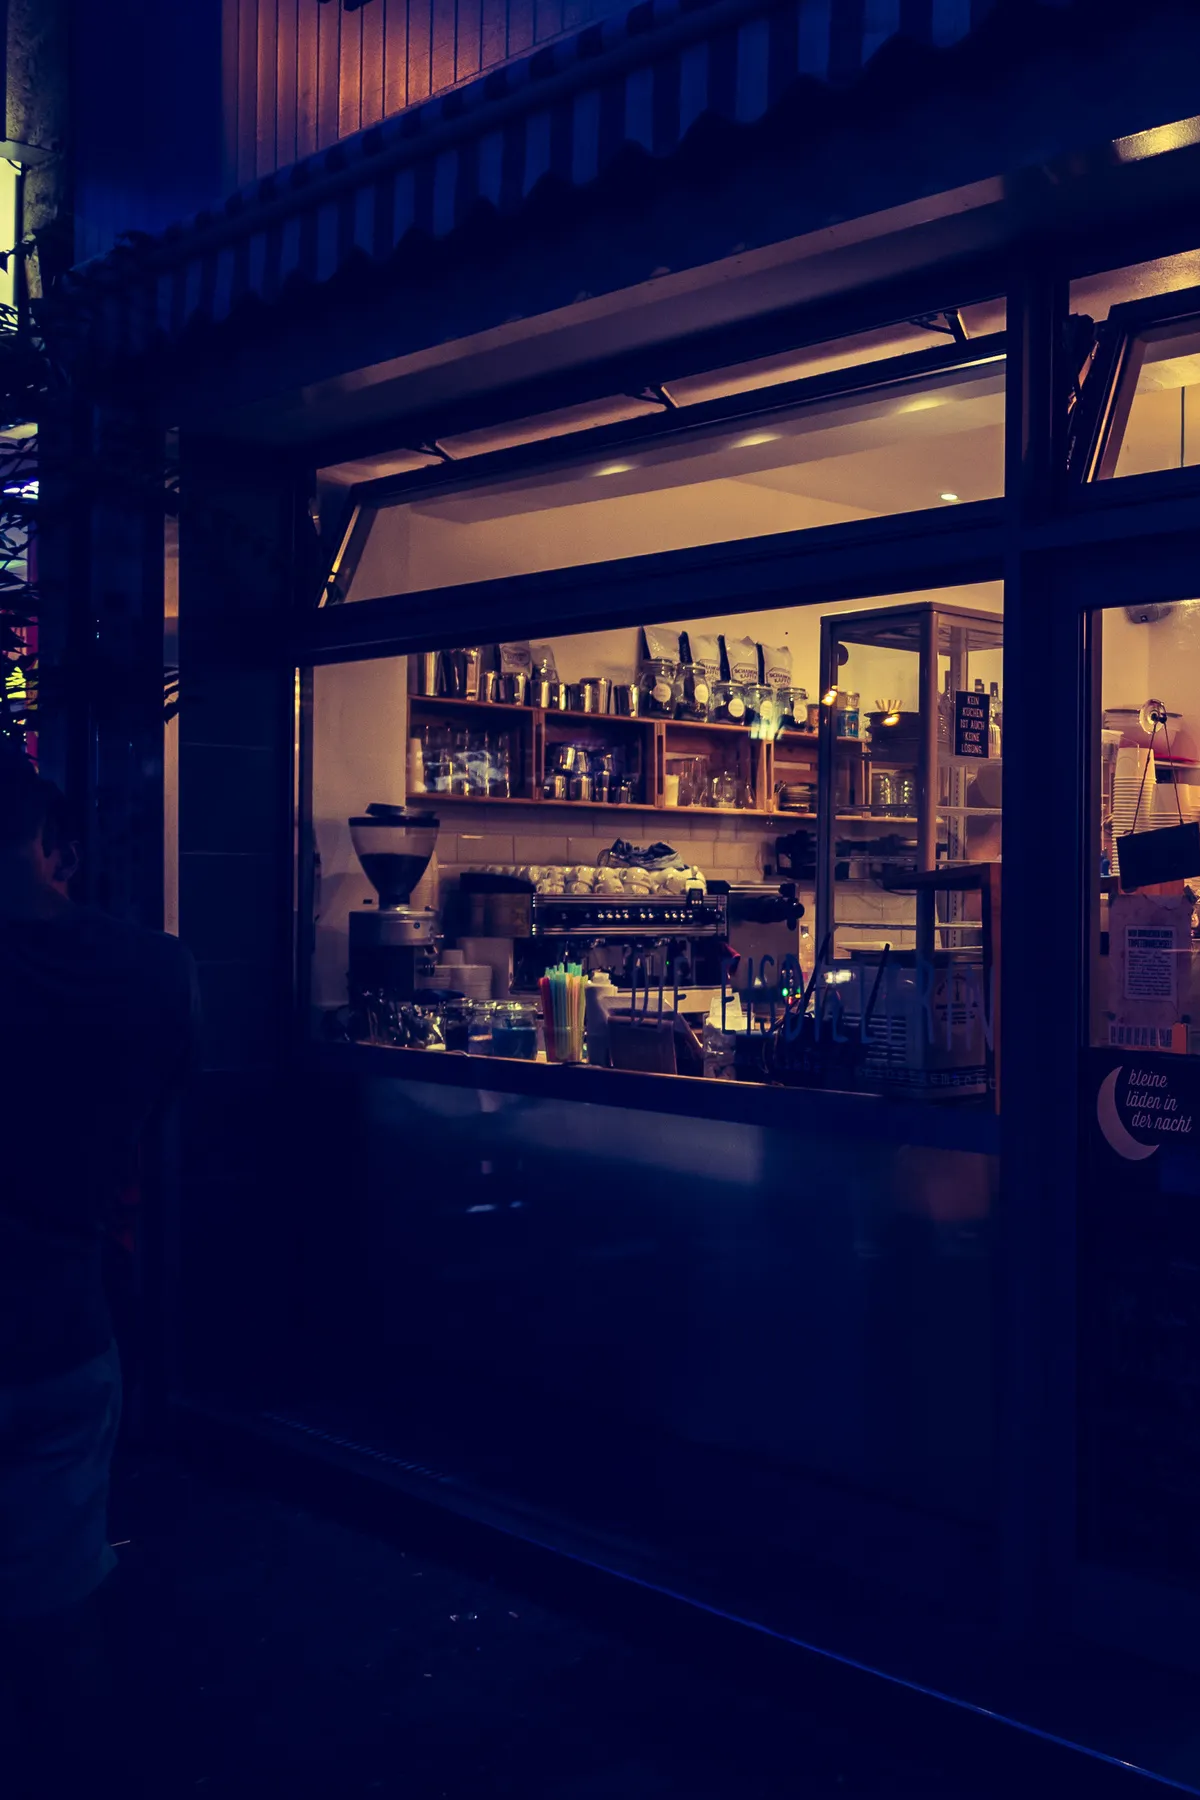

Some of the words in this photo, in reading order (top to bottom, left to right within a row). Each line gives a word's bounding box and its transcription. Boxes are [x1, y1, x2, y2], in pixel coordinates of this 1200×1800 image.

[966, 695, 980, 706] KEIN
[962, 706, 984, 718] KUCHEN
[960, 718, 969, 729] IST
[970, 719, 985, 730] AUCH
[964, 731, 980, 742] KEINE
[1128, 1069, 1168, 1088] kleine
[1126, 1090, 1162, 1110] läden
[1164, 1094, 1178, 1112] in
[1132, 1110, 1154, 1129] der
[1155, 1115, 1193, 1133] nacht
